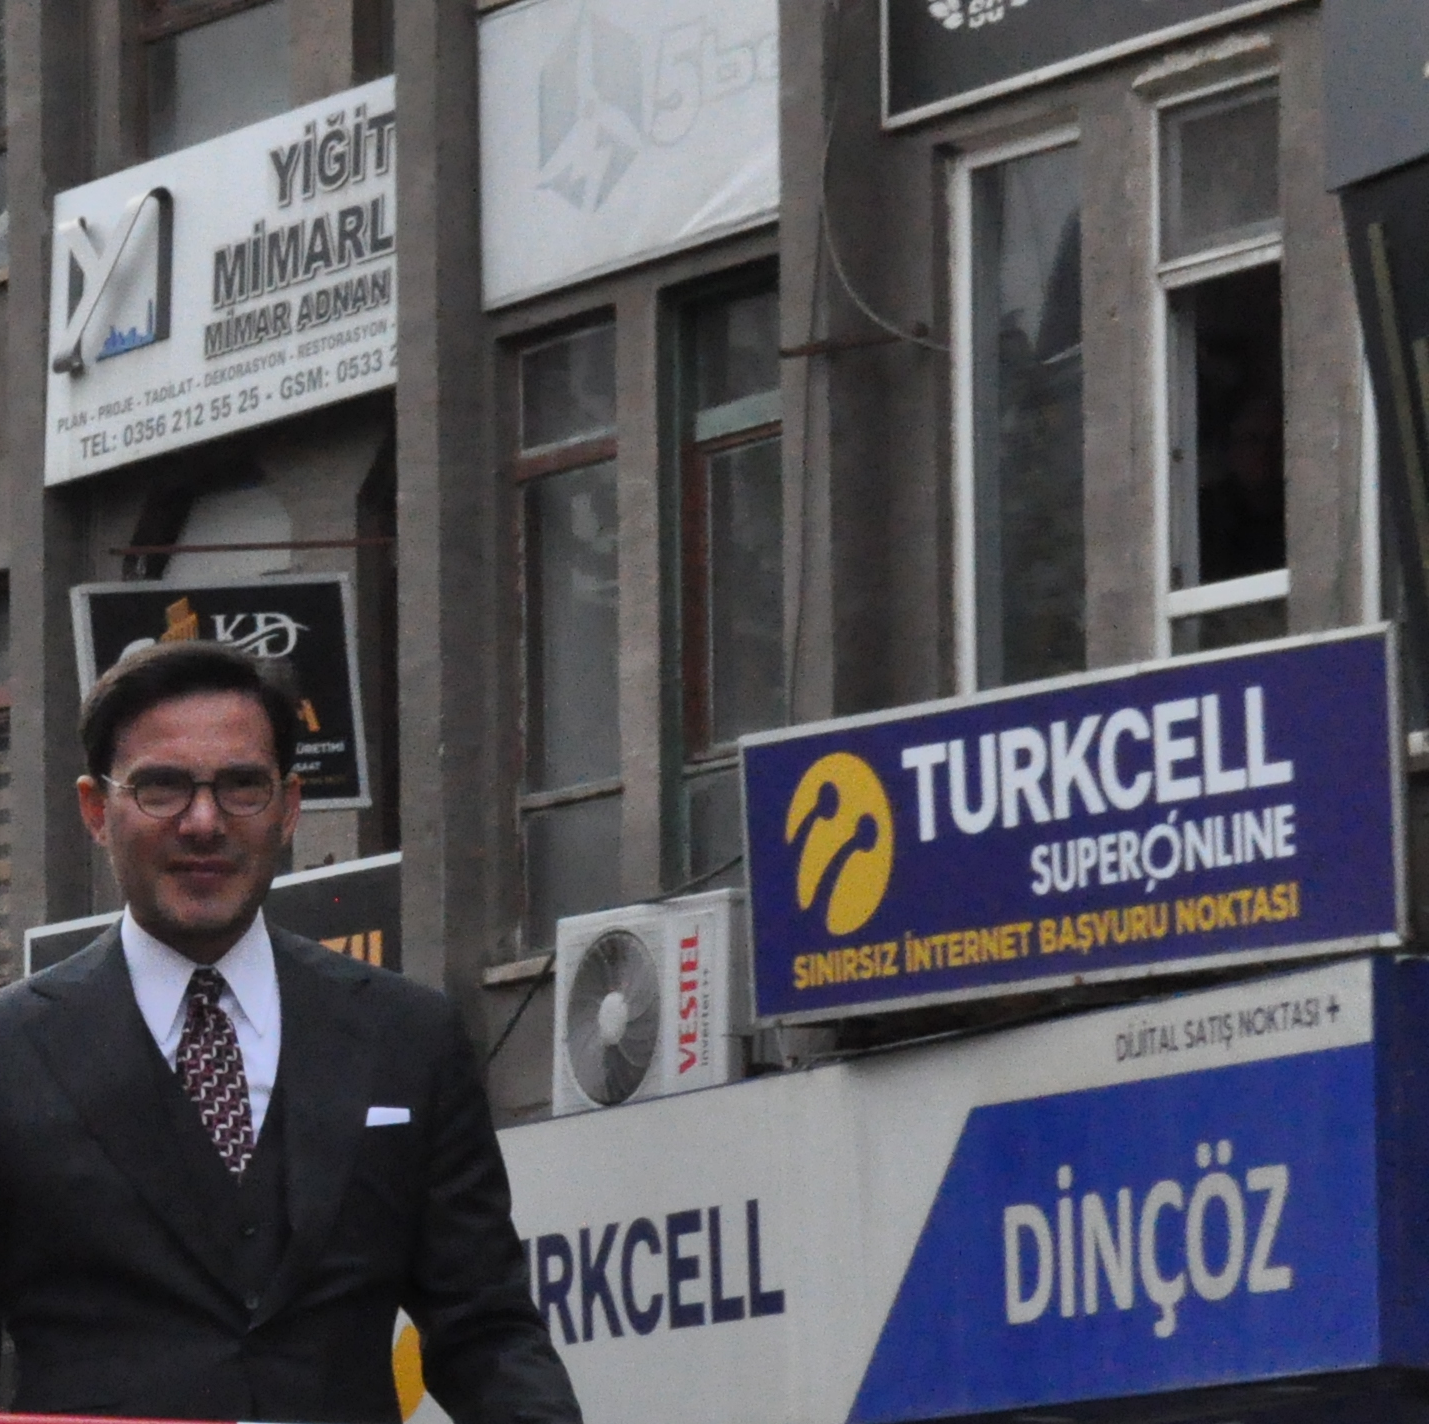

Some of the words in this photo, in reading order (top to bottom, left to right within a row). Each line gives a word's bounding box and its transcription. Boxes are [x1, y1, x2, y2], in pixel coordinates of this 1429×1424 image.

[269, 103, 395, 208] YİĞİT
[204, 308, 290, 360] MİMAR
[296, 267, 391, 331] ADNAN
[58, 411, 87, 434] PLAN
[98, 399, 134, 422] PROJE
[144, 378, 193, 408] TADİLAT
[204, 354, 287, 389] DEKORASYON
[297, 321, 388, 360] RESTORASYON
[79, 431, 117, 460] TEL:
[123, 414, 166, 447] 0356
[171, 404, 204, 434] 212
[210, 396, 232, 422] 55
[238, 386, 260, 414] 25
[280, 365, 330, 401] GSM:
[336, 347, 383, 384] 0533
[901, 687, 1295, 843] TURKCELL
[794, 940, 898, 990] SINIRSIZ
[905, 921, 1033, 973] İNTERNET
[1039, 900, 1168, 956] BAŞVURU
[1175, 881, 1300, 935] NOKTASI
[679, 924, 699, 1074] VESTEL
[1185, 1009, 1234, 1049] SATIŞ
[1239, 997, 1321, 1040] NOKTASI
[1003, 1139, 1293, 1338] DİNÇÖZ
